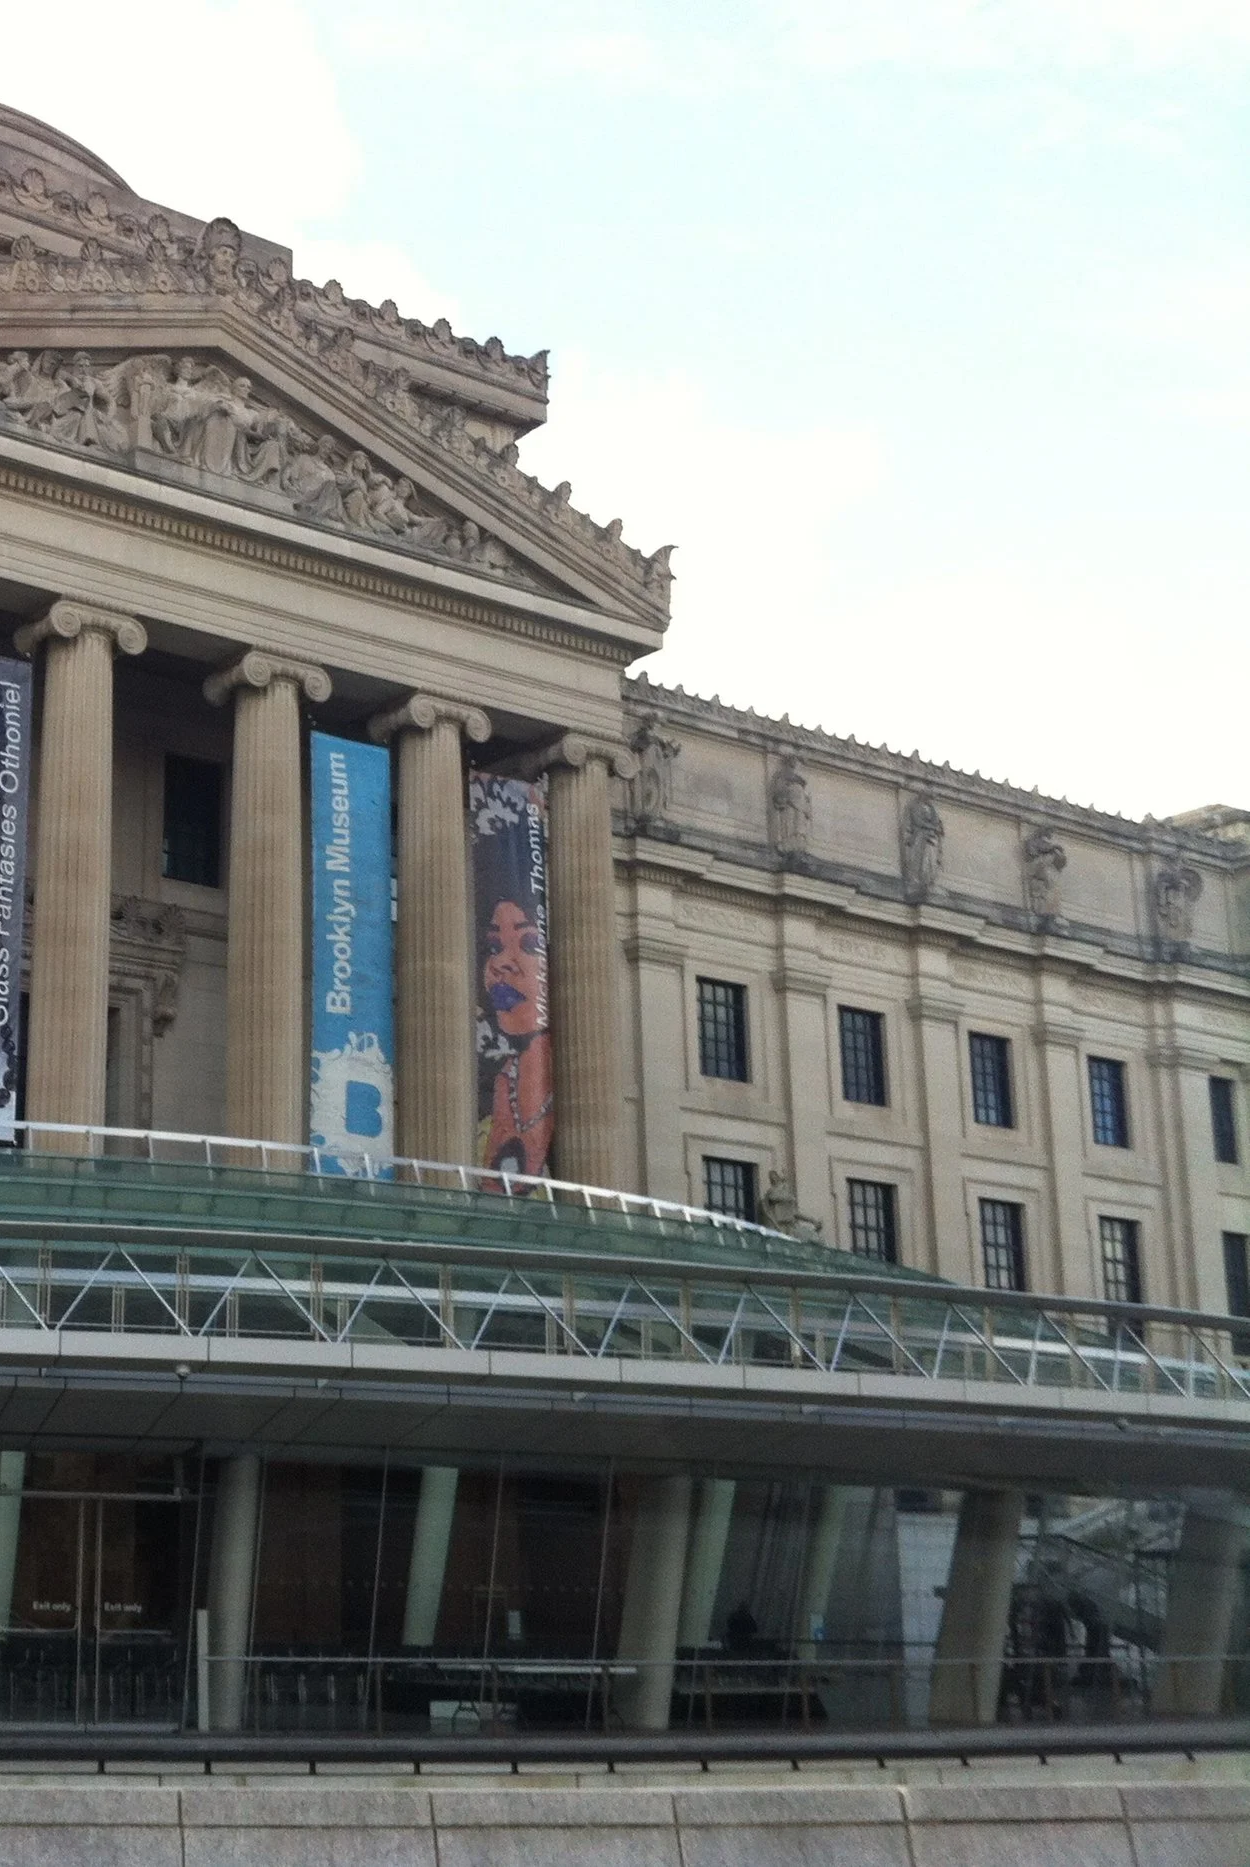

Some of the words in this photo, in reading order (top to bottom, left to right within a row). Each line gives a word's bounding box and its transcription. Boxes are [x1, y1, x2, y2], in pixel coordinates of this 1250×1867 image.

[326, 752, 351, 873] Museum
[526, 802, 544, 894] Thomas
[325, 879, 357, 1015] Brooklyn
